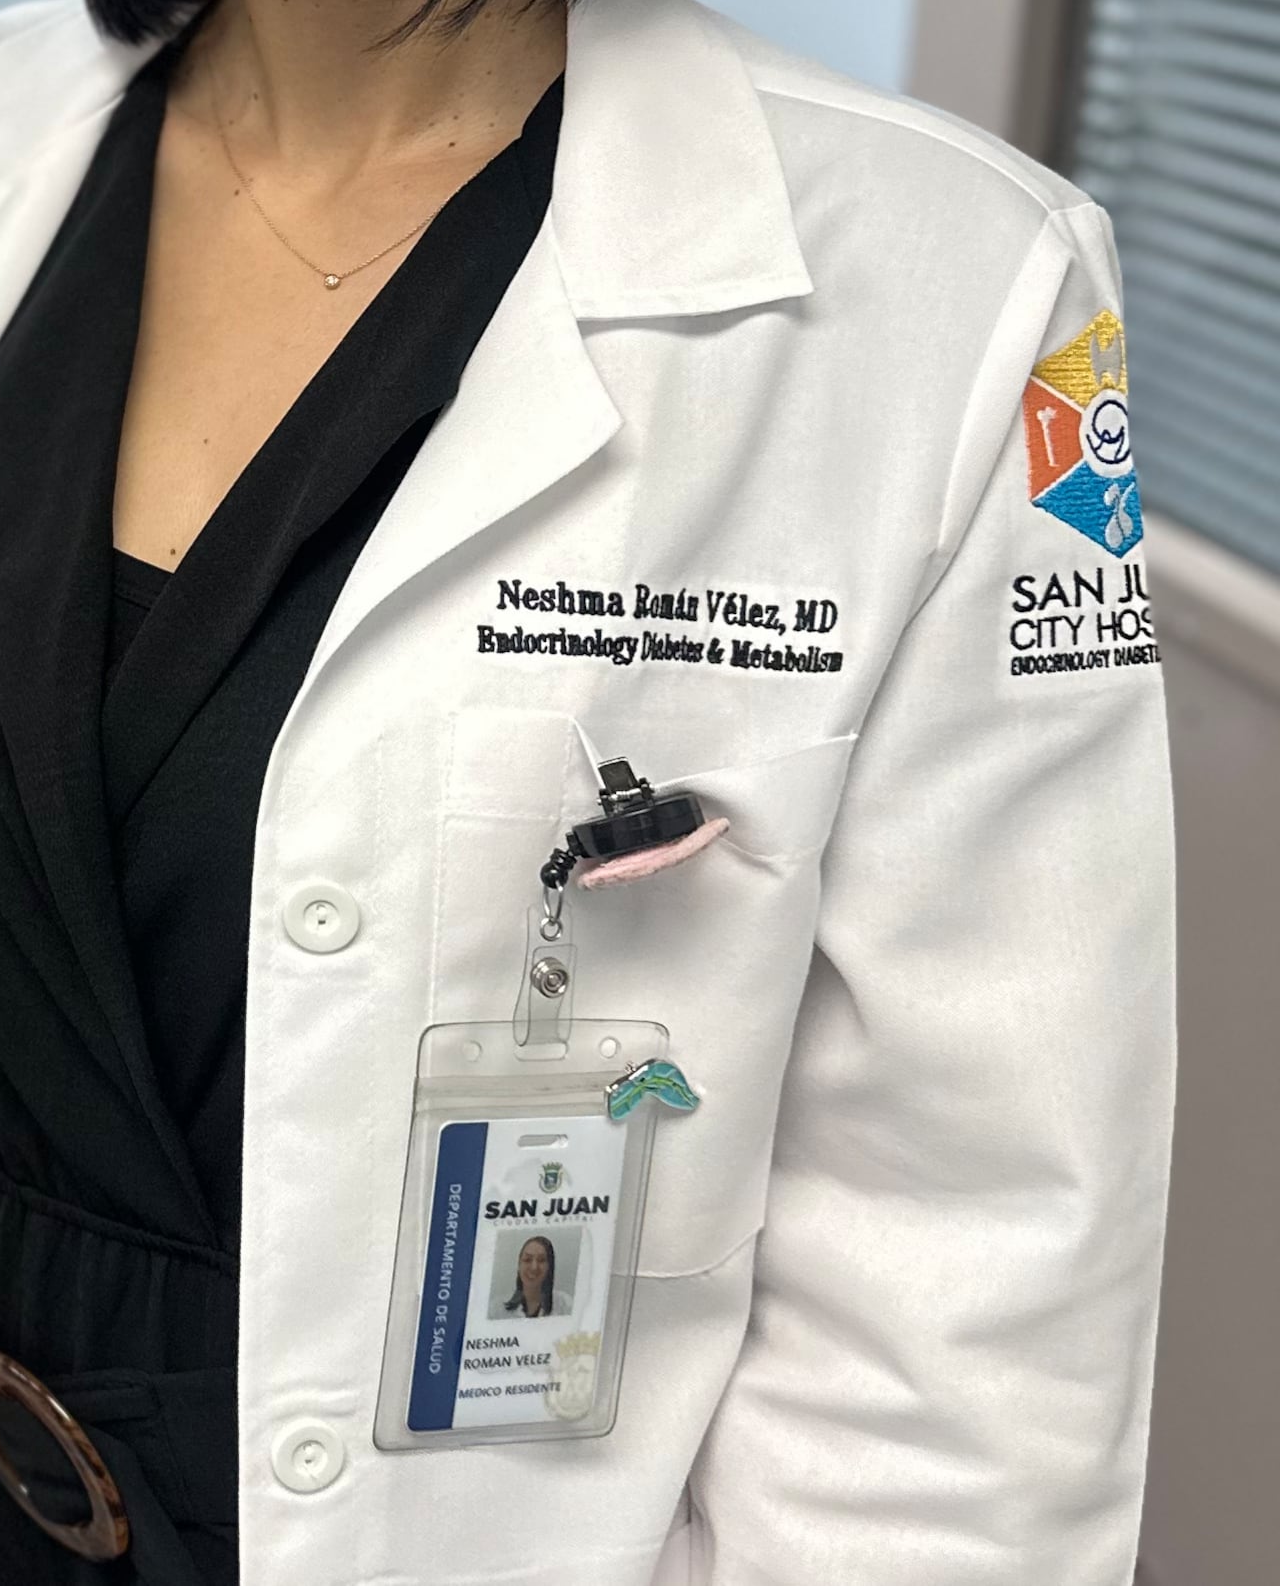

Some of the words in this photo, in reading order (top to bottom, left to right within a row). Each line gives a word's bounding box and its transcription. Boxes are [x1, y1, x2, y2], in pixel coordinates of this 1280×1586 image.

[497, 579, 625, 617] Neshma
[633, 583, 699, 622] Román
[706, 589, 787, 636] Vélez,
[792, 599, 839, 633] MD
[1011, 567, 1104, 613] SAN
[476, 625, 639, 665] Endocrinology
[641, 630, 705, 664] Diabetes
[706, 638, 725, 664] &
[729, 639, 845, 674] Metabolism
[1010, 615, 1086, 651] CITY
[484, 1198, 538, 1220] SAN
[542, 1195, 610, 1217] JUAN
[437, 1183, 462, 1301] DEPARTAMENTO
[435, 1304, 448, 1324] DE
[429, 1327, 446, 1375] SALUD
[465, 1336, 520, 1350] NESHMA
[463, 1355, 512, 1370] ROMAN
[516, 1353, 552, 1366] VELEZ
[458, 1386, 502, 1399] MEDICO
[505, 1381, 562, 1396] RESIDENTE
